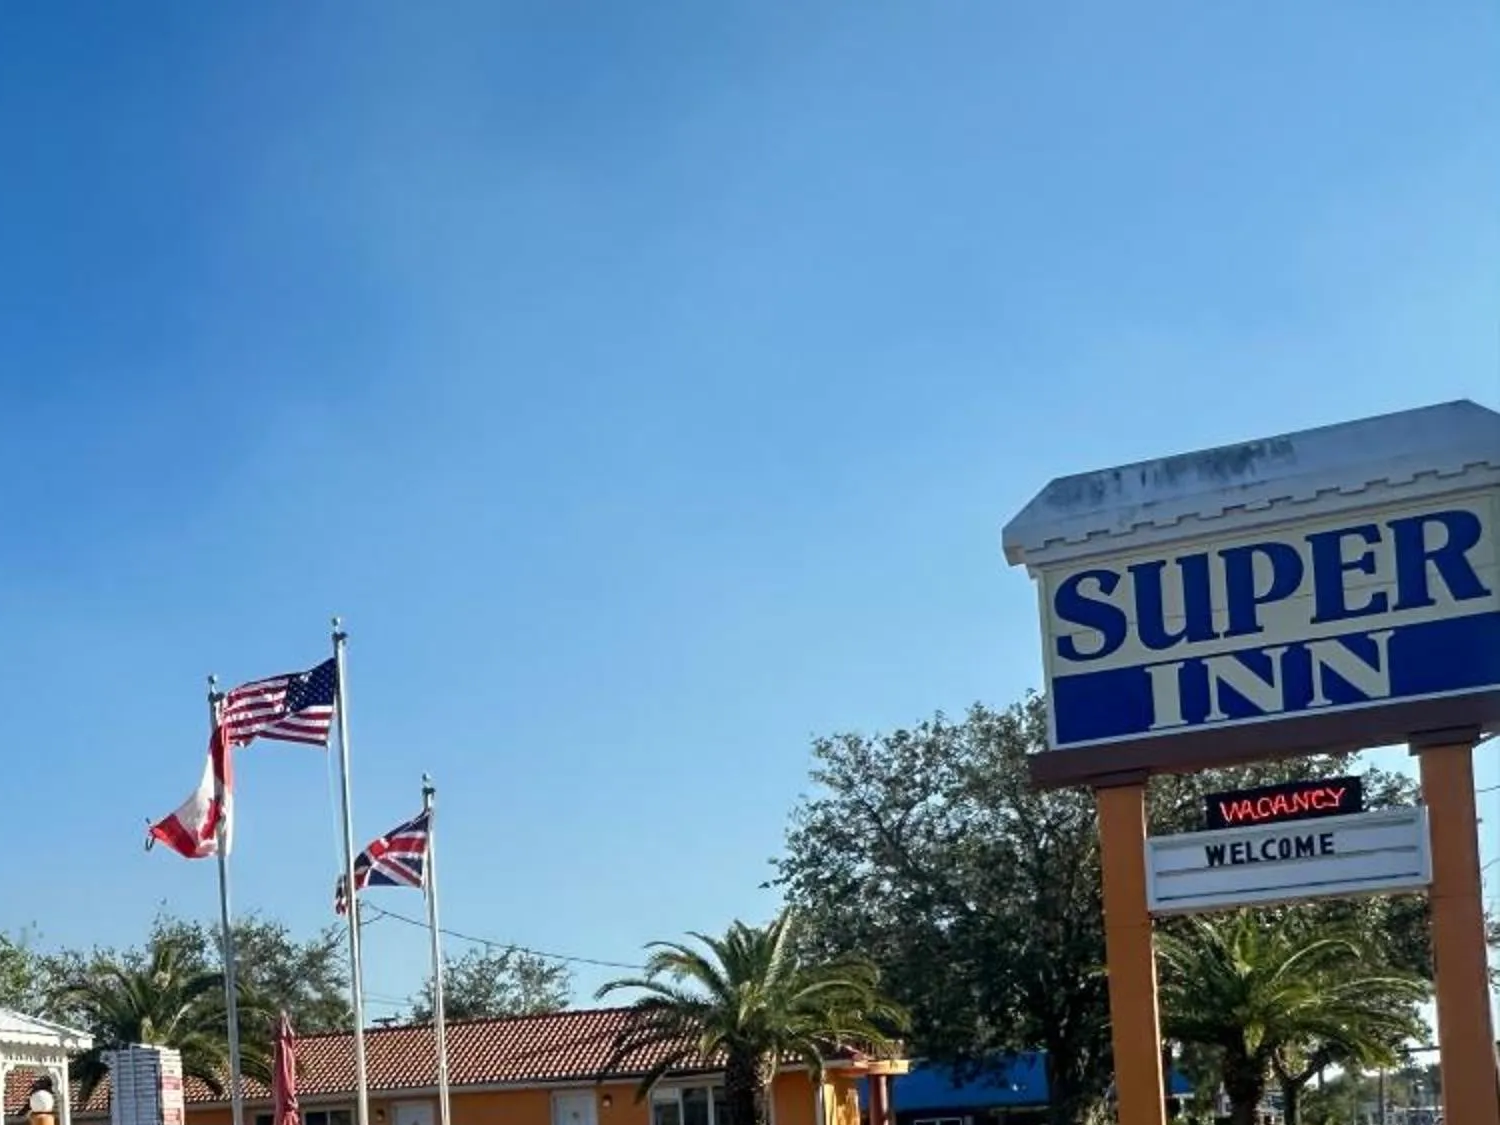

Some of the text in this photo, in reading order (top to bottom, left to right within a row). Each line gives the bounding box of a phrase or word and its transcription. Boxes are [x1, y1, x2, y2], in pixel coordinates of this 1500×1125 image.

[1053, 509, 1492, 662] SUPER
[1144, 629, 1395, 732] INN
[1218, 786, 1347, 823] VACANCY
[1204, 832, 1336, 867] WELCOME
